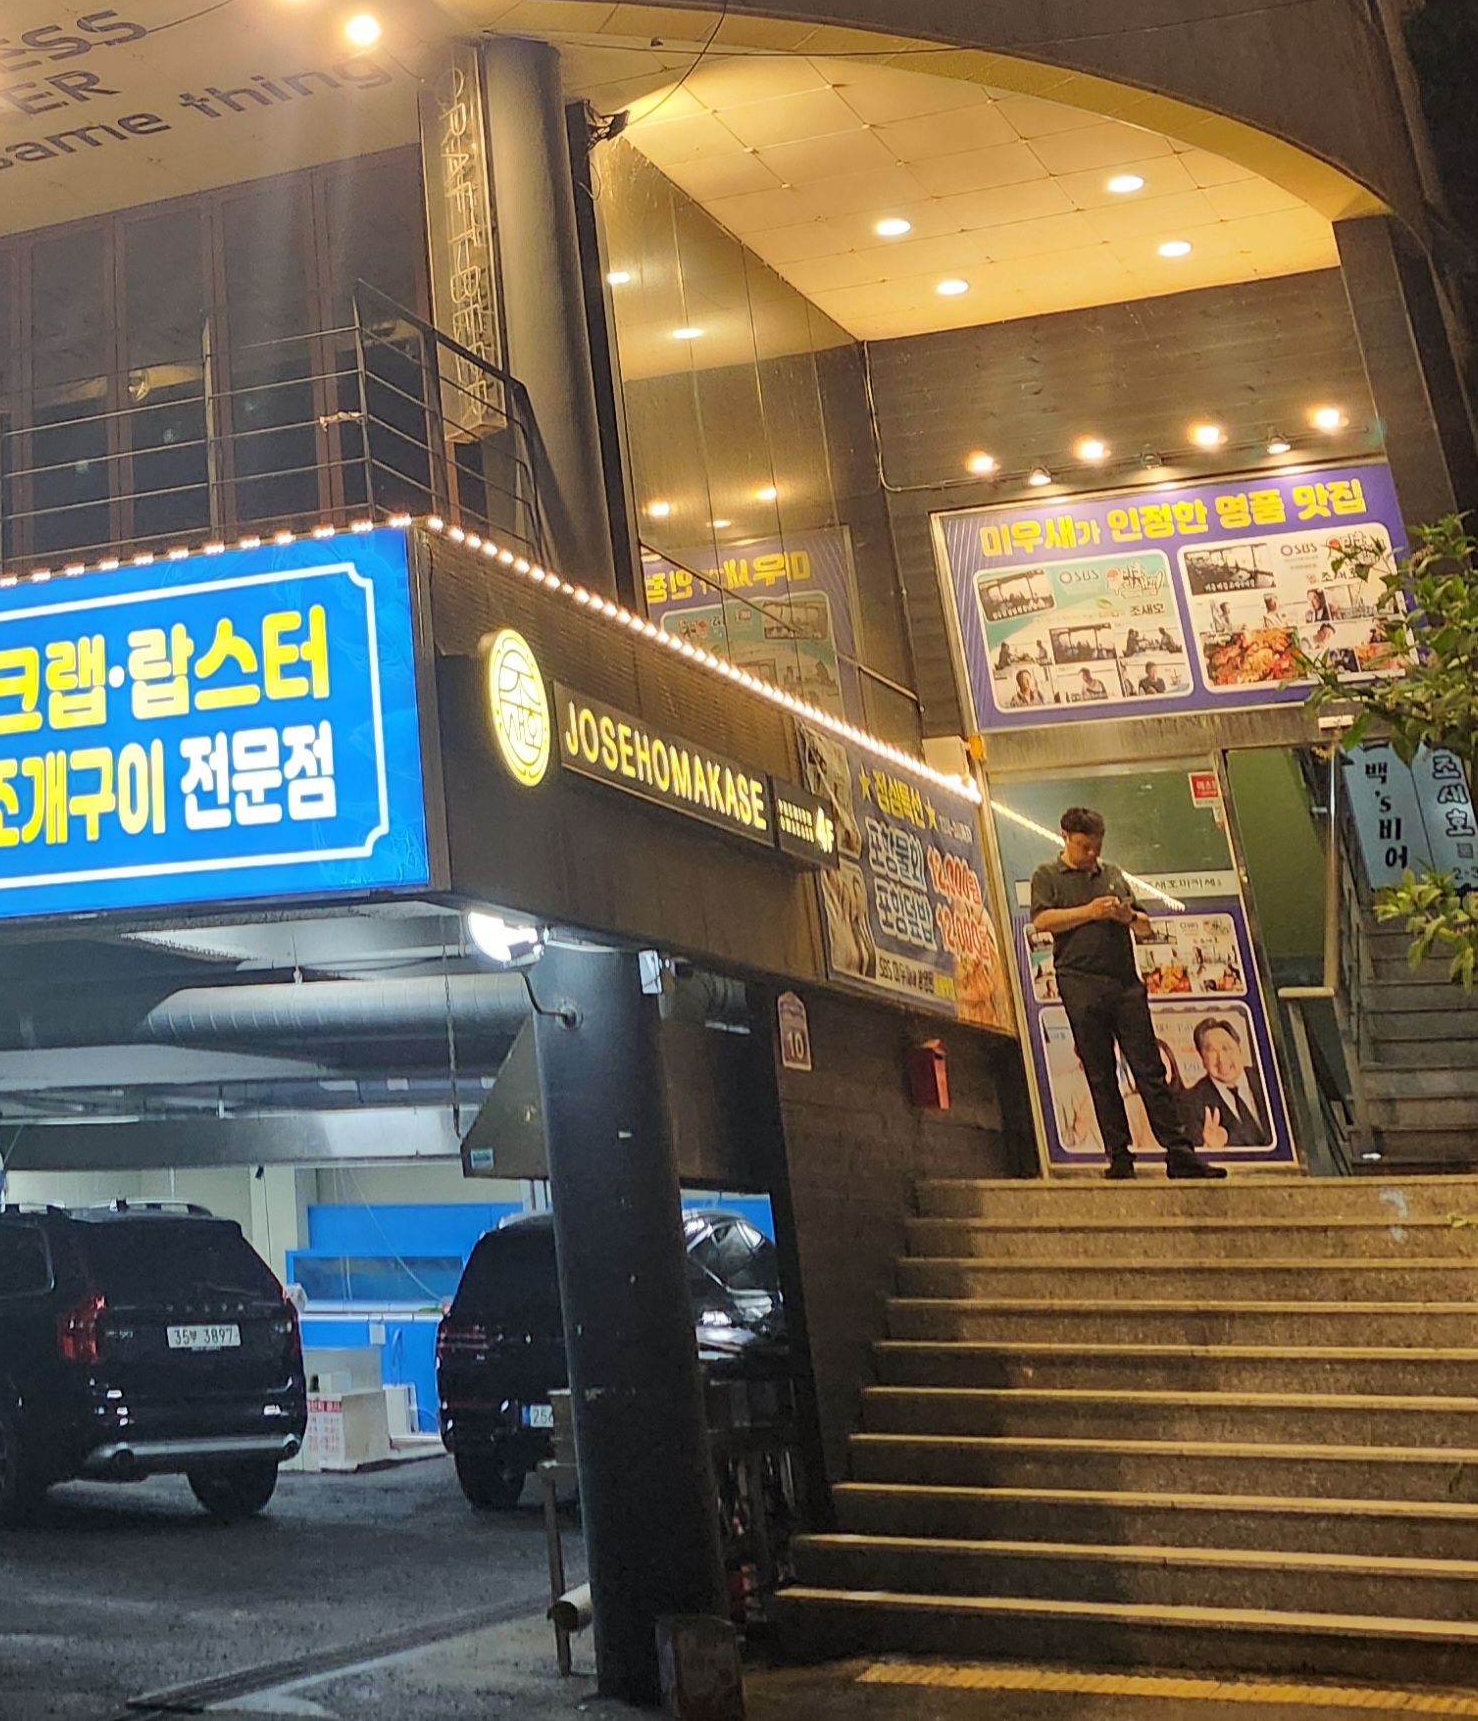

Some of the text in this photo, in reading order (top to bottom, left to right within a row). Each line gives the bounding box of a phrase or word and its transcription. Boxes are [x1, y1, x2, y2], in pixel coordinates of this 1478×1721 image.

[177, 55, 396, 120] thing
[980, 477, 1367, 558] 미우새가 인정한 명품 맛집
[178, 720, 338, 832] 전문점
[564, 700, 768, 831] JOSEHOMAKASE
[872, 769, 926, 830] 점심특선
[1432, 753, 1476, 838] 조새호
[864, 815, 927, 893] 포항물회
[787, 1031, 805, 1059] 10
[203, 1327, 235, 1344] 3897
